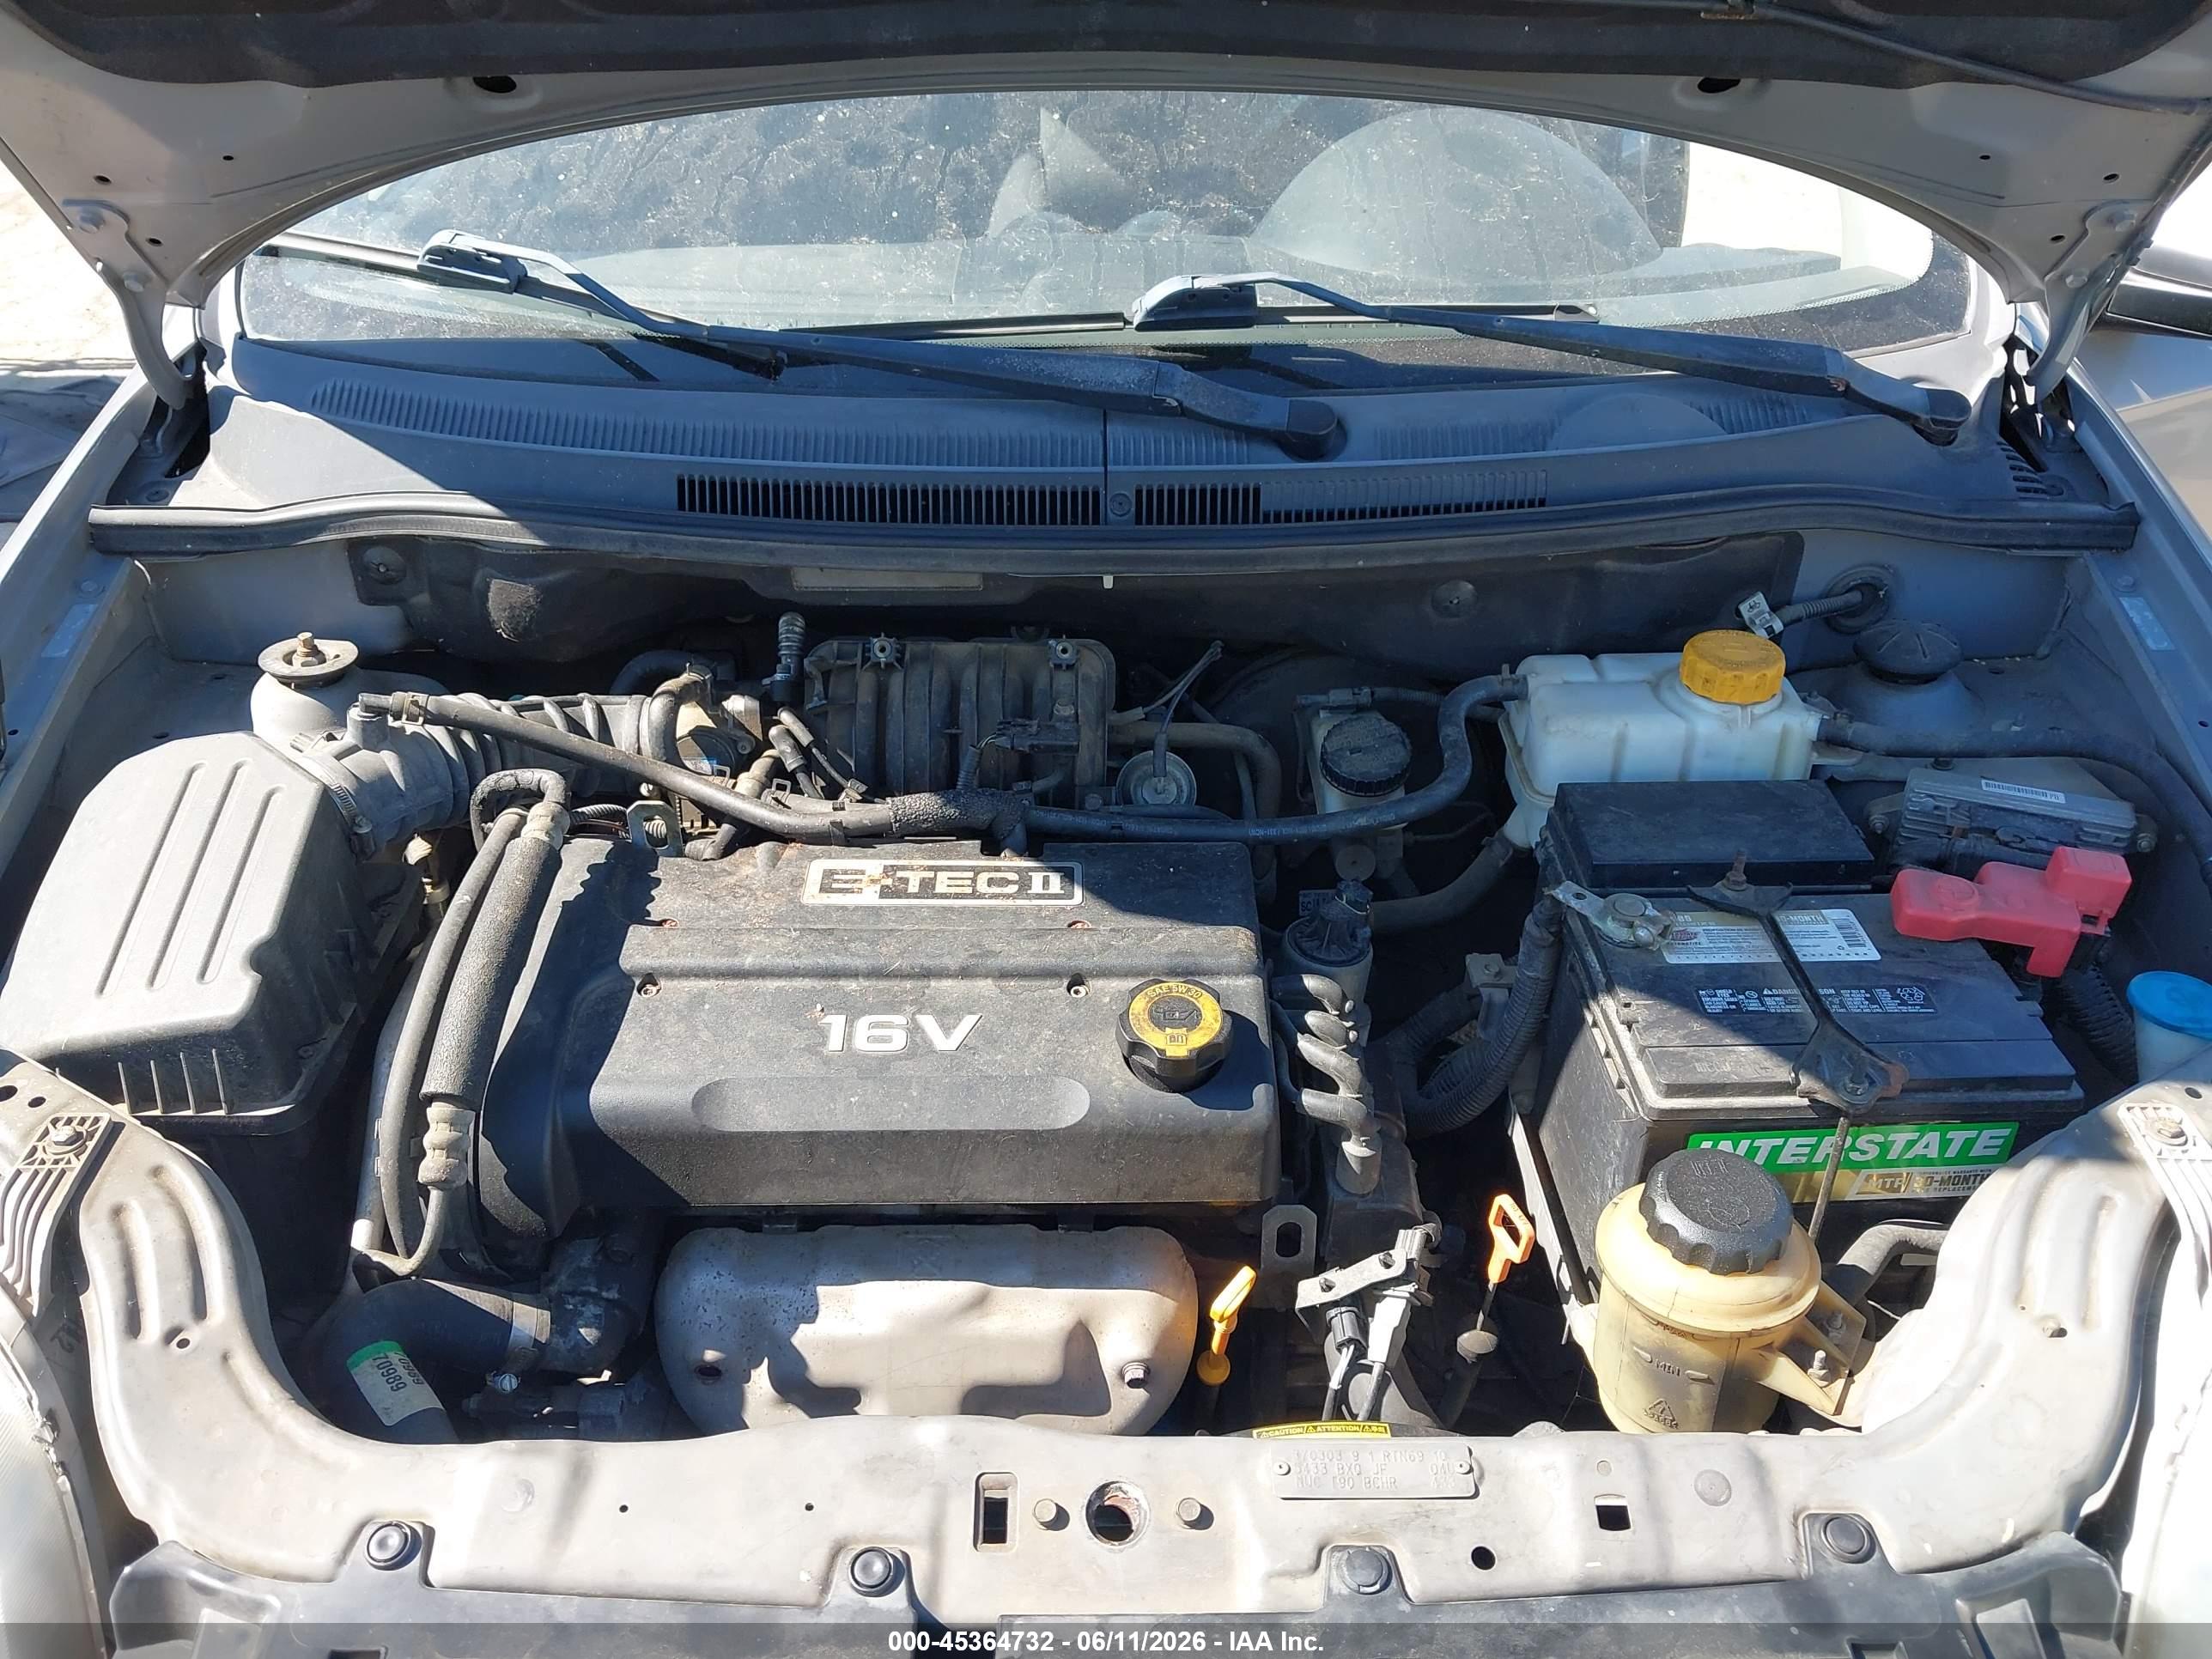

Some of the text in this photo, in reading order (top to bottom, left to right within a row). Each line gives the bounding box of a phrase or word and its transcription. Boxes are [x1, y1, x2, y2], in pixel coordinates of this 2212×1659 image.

[1147, 984, 1170, 998] SAE
[817, 1013, 983, 1053] 16V
[371, 1352, 408, 1393] 70989
[1269, 1426, 1304, 1437] CAUTION
[1316, 1425, 1360, 1433] ATTENTION
